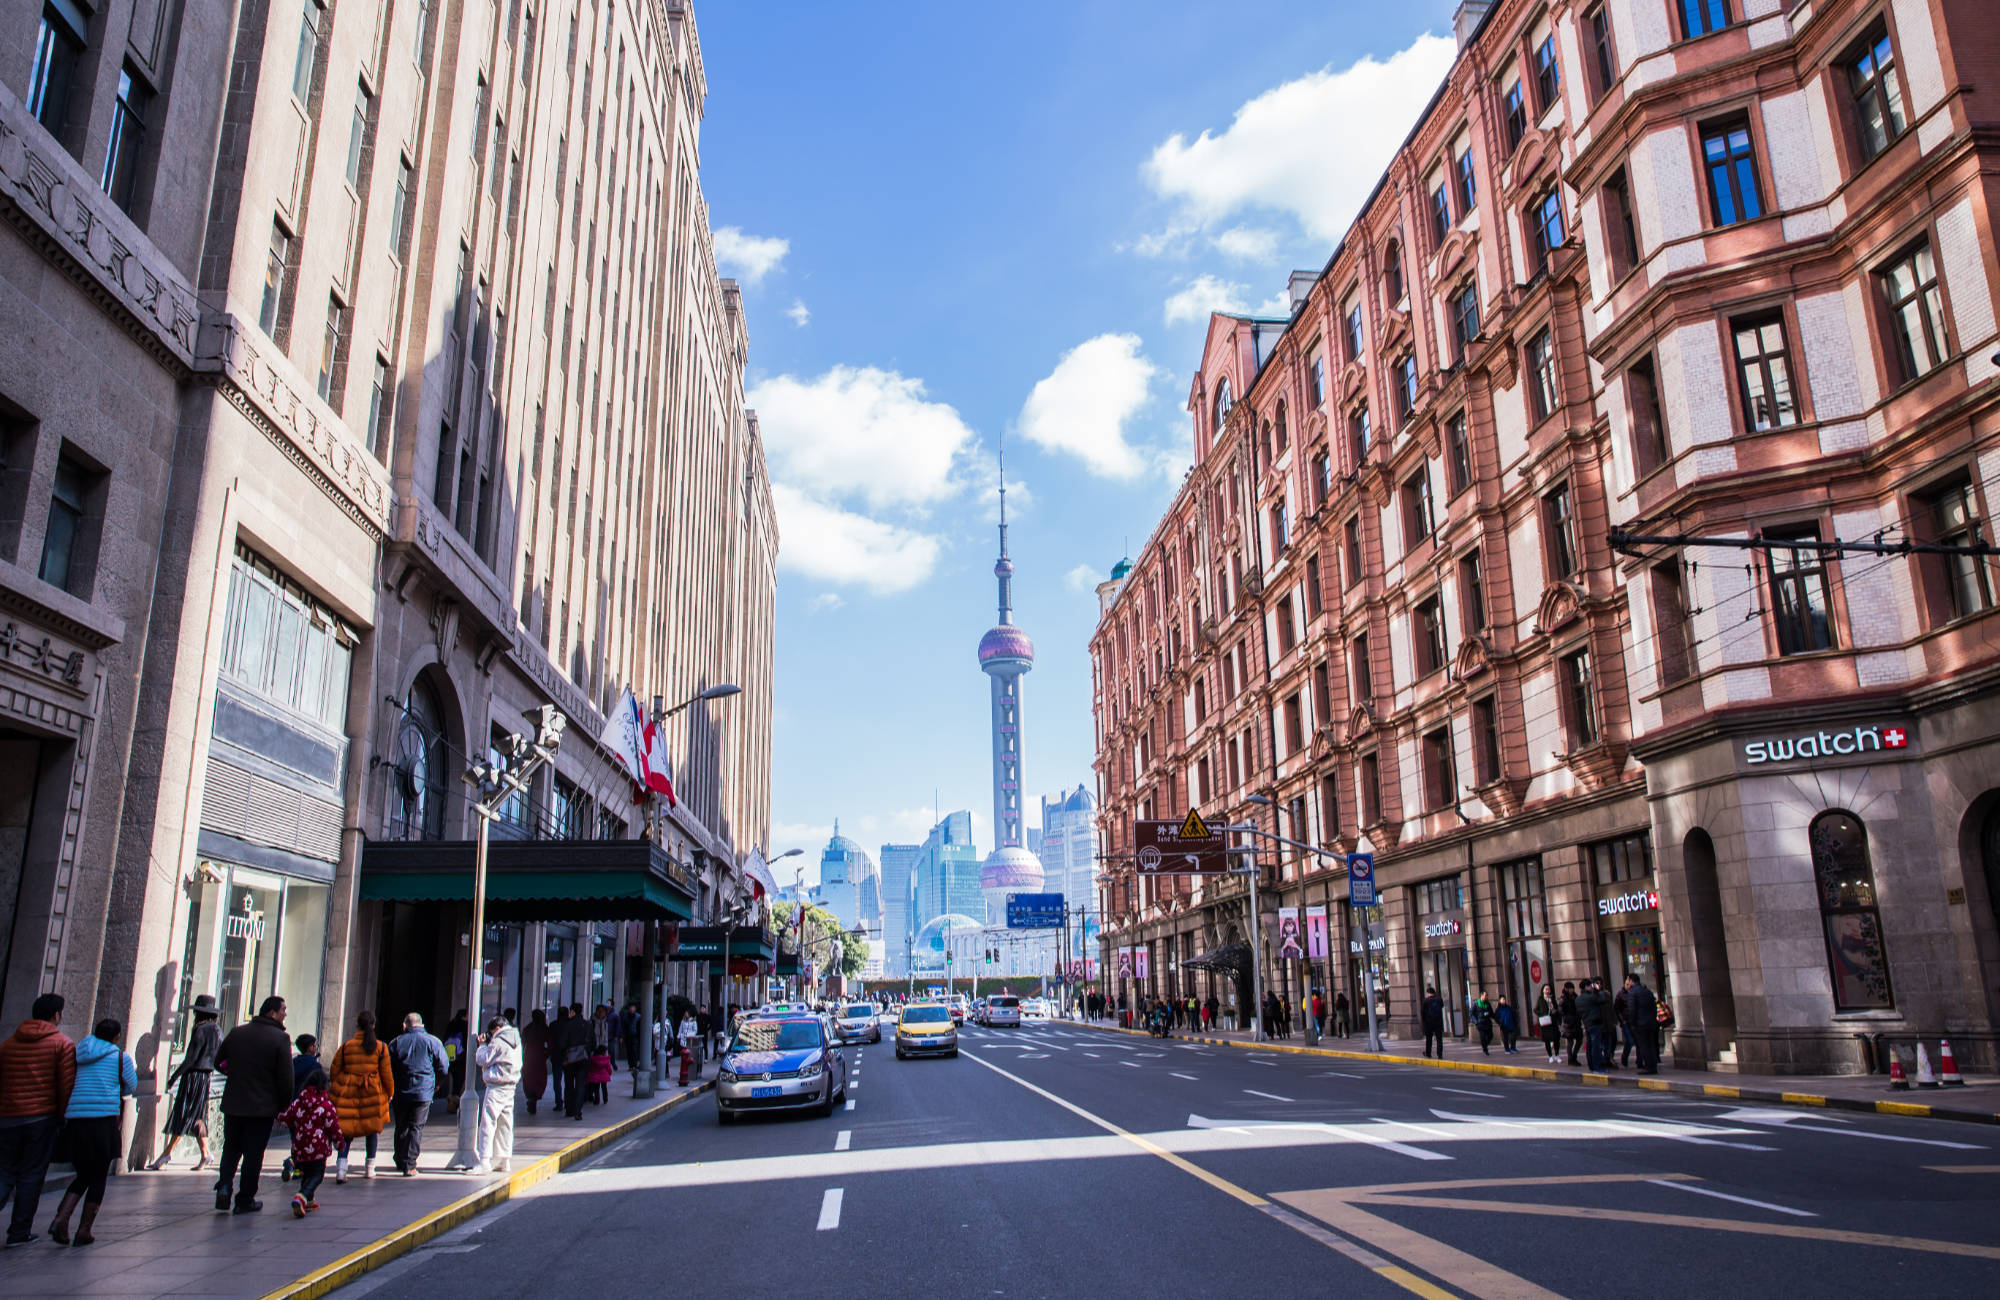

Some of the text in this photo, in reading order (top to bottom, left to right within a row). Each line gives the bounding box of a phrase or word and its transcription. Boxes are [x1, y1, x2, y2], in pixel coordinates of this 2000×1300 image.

[1745, 726, 1880, 763] swatch
[1157, 824, 1222, 835] 外滩道
[1599, 890, 1648, 915] swatch
[227, 915, 265, 941] TITONI
[1424, 919, 1454, 937] swatch
[1350, 936, 1385, 952] BLAPAIN
